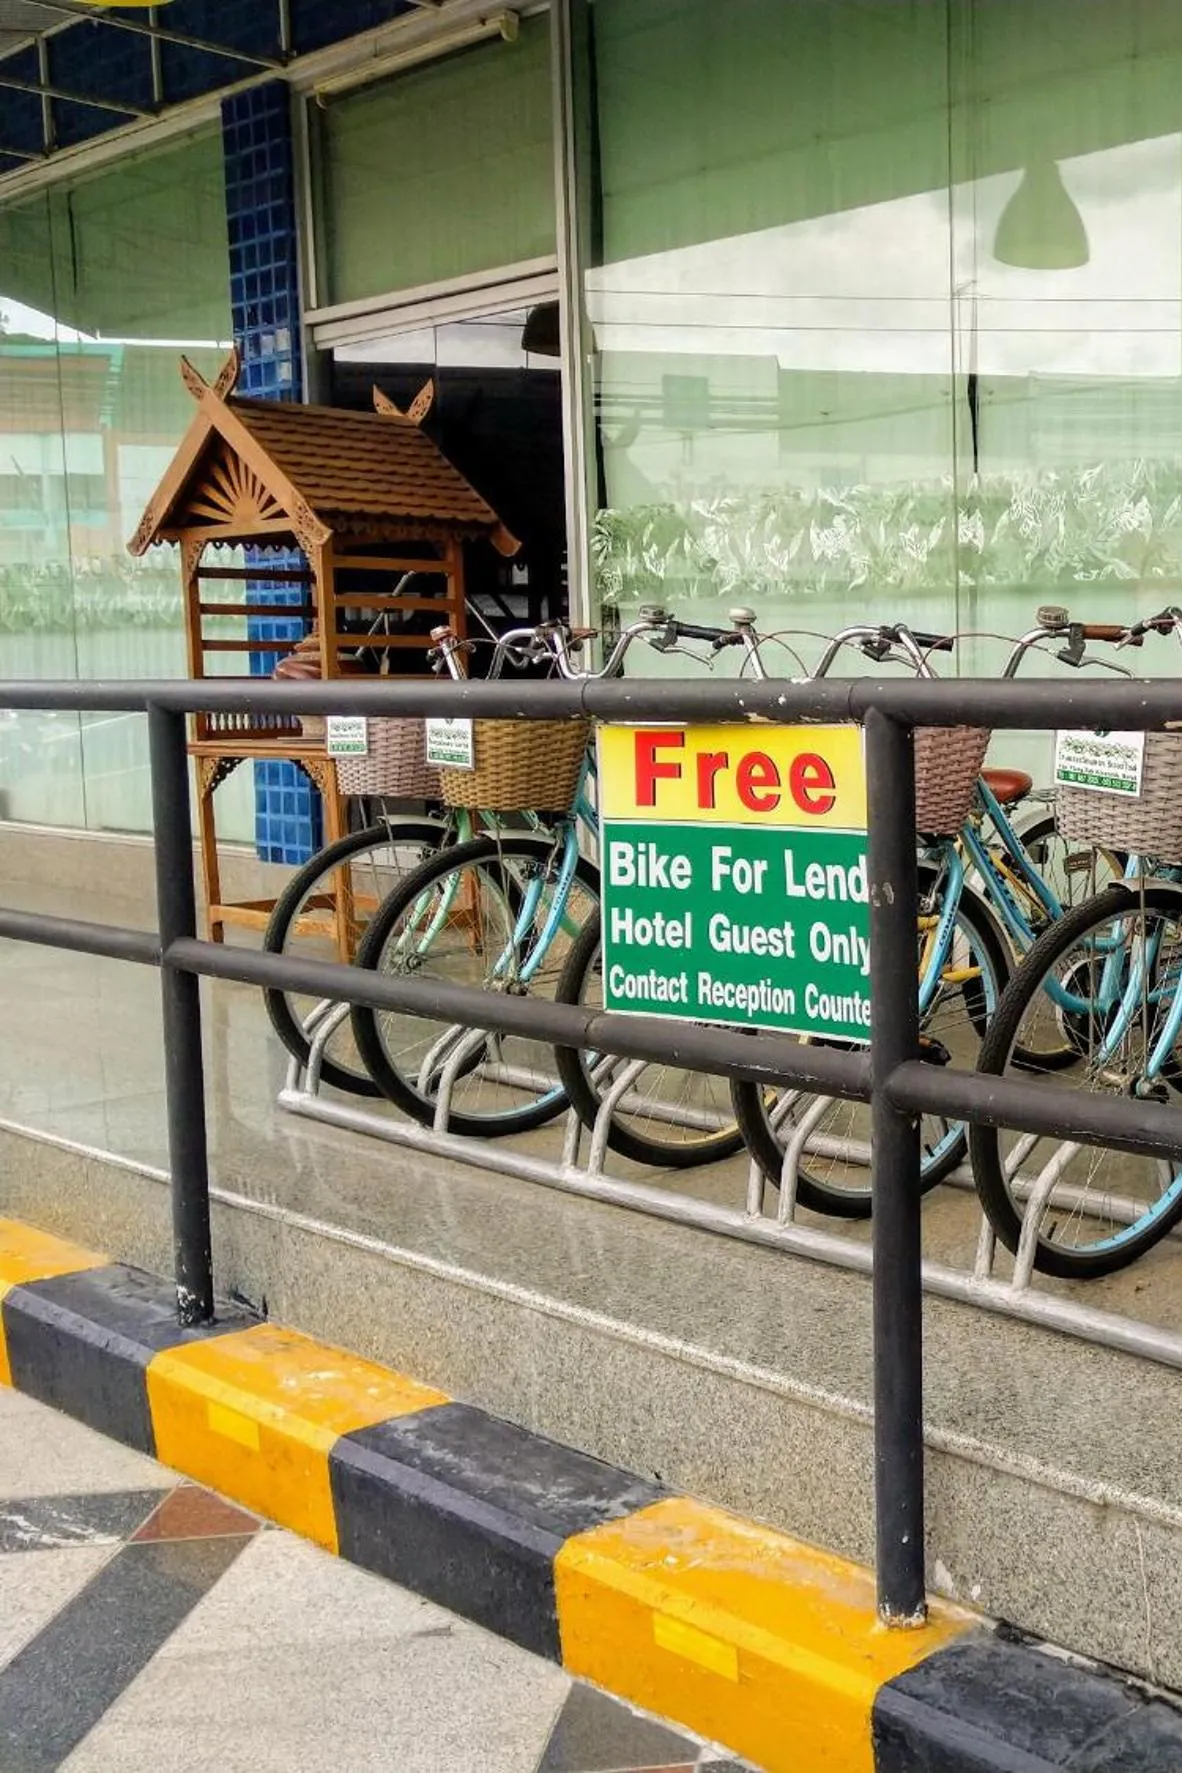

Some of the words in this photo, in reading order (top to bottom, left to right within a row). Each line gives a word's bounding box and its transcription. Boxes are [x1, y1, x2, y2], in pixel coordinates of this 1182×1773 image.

[634, 730, 836, 815] Free
[609, 841, 692, 889] Bike
[711, 846, 768, 894] For
[785, 850, 869, 903] Lend
[611, 908, 692, 949] Hotel
[709, 913, 794, 958] Guest
[810, 922, 870, 974] Only
[610, 966, 688, 1001] Contact
[698, 972, 795, 1017] Reception
[805, 983, 872, 1025] Counte
